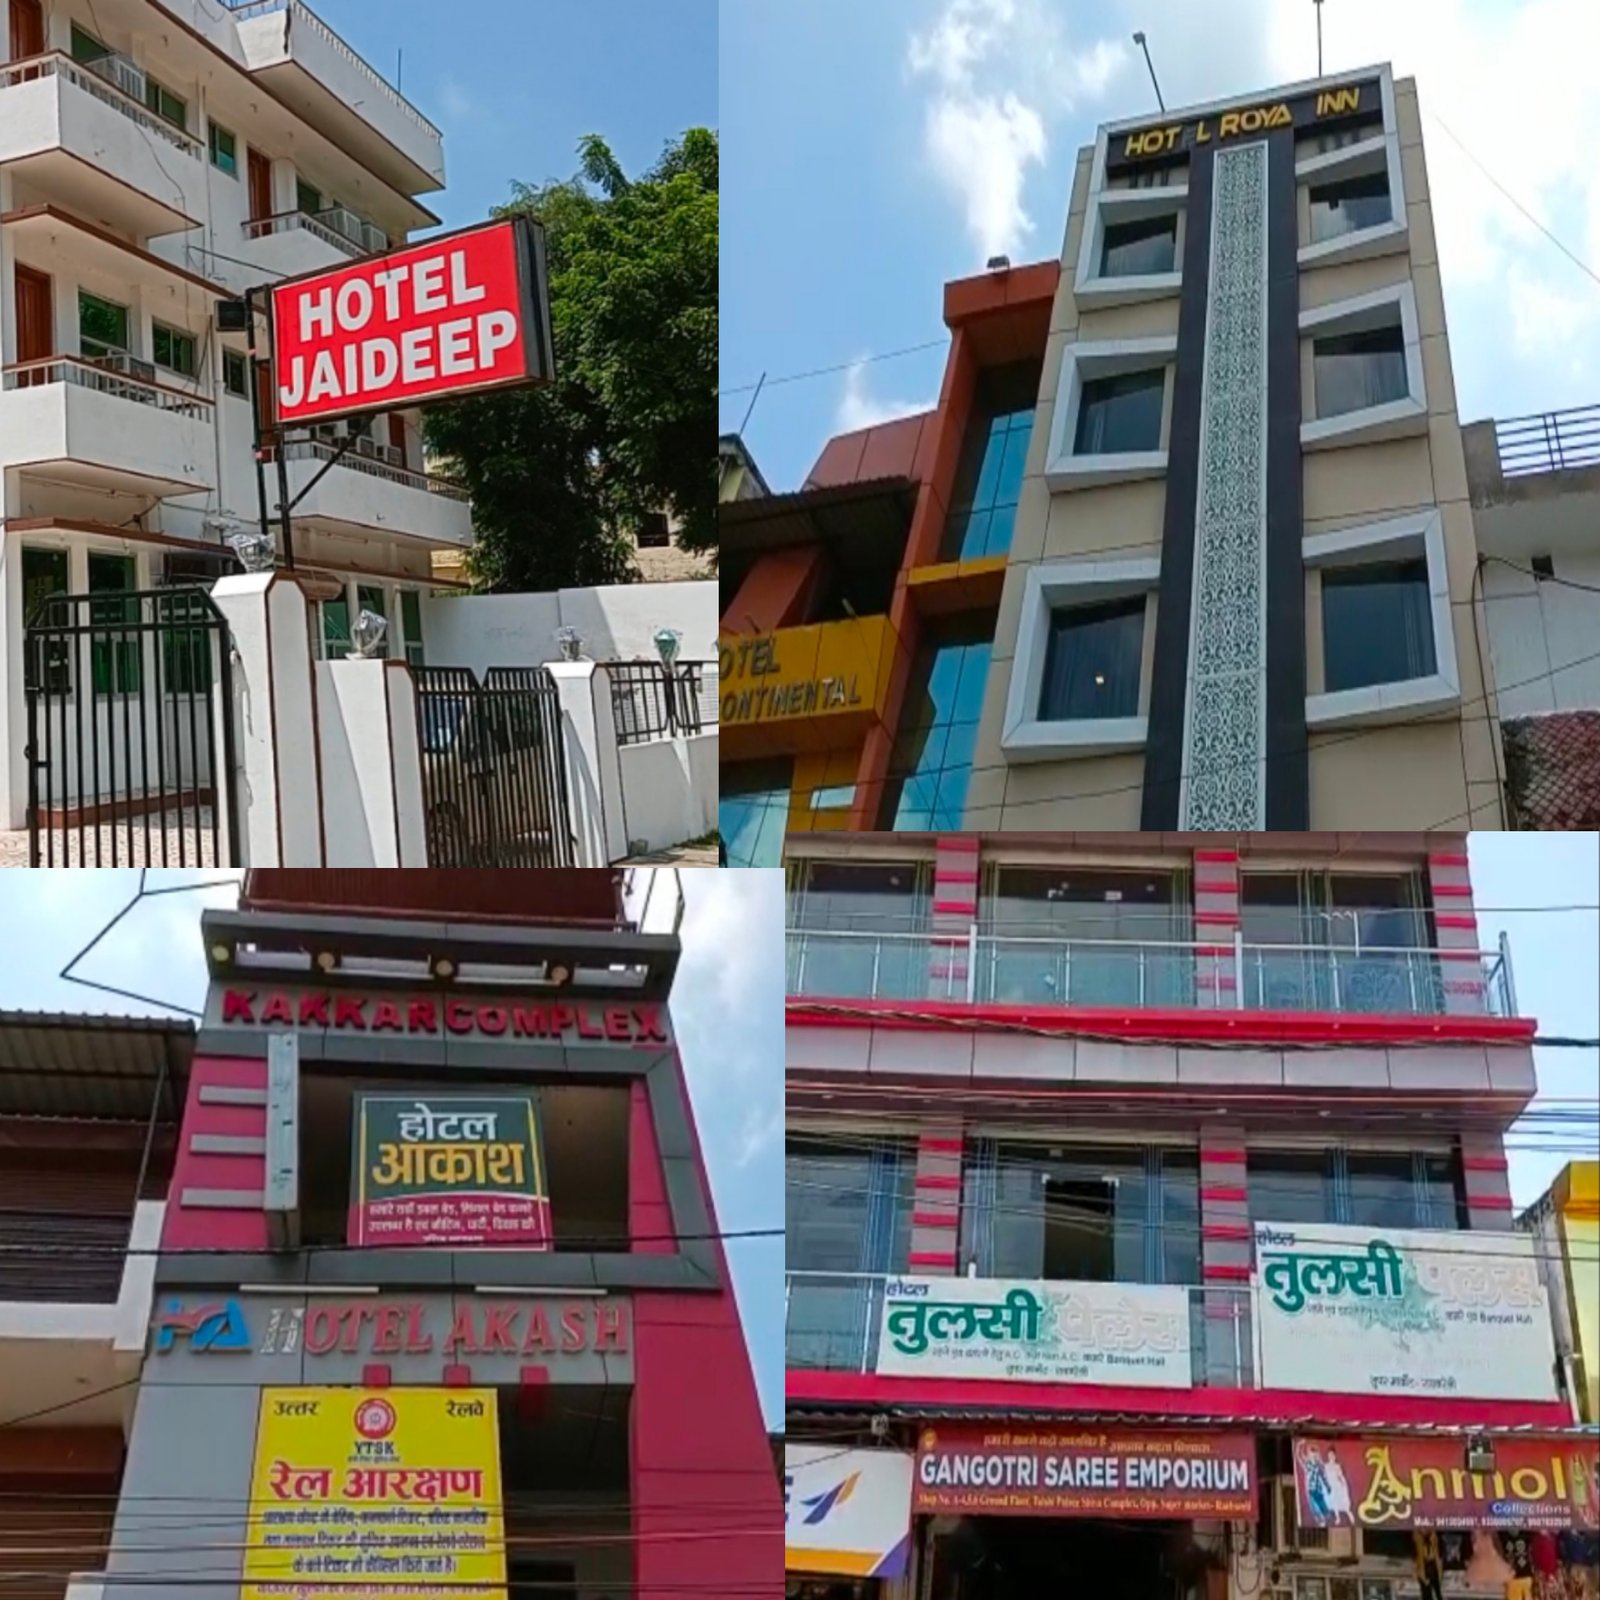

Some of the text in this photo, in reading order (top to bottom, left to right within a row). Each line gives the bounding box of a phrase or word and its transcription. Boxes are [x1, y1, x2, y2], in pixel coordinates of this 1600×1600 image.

[1220, 103, 1292, 137] ROYA
[1316, 88, 1359, 116] INN
[299, 250, 486, 343] HOTEL
[280, 310, 517, 408] JAIDEEP
[222, 989, 667, 1042] KAKKAR COMPLEX
[397, 1102, 498, 1141] होटल
[372, 1144, 525, 1185] आकाश
[1262, 1239, 1403, 1312] तुलसी
[260, 1304, 628, 1357] HOTEL AKASH
[888, 1289, 1042, 1354] तुलसी
[273, 1399, 485, 1418] उत्तर रेलवे
[354, 1440, 394, 1455] YTSK
[920, 1453, 1249, 1490] GANGOTRI SAREE EMPORIUM
[270, 1461, 484, 1502] रेल आरक्षण
[1358, 1445, 1567, 1524] Anmol
[1492, 1502, 1571, 1515] Collections
